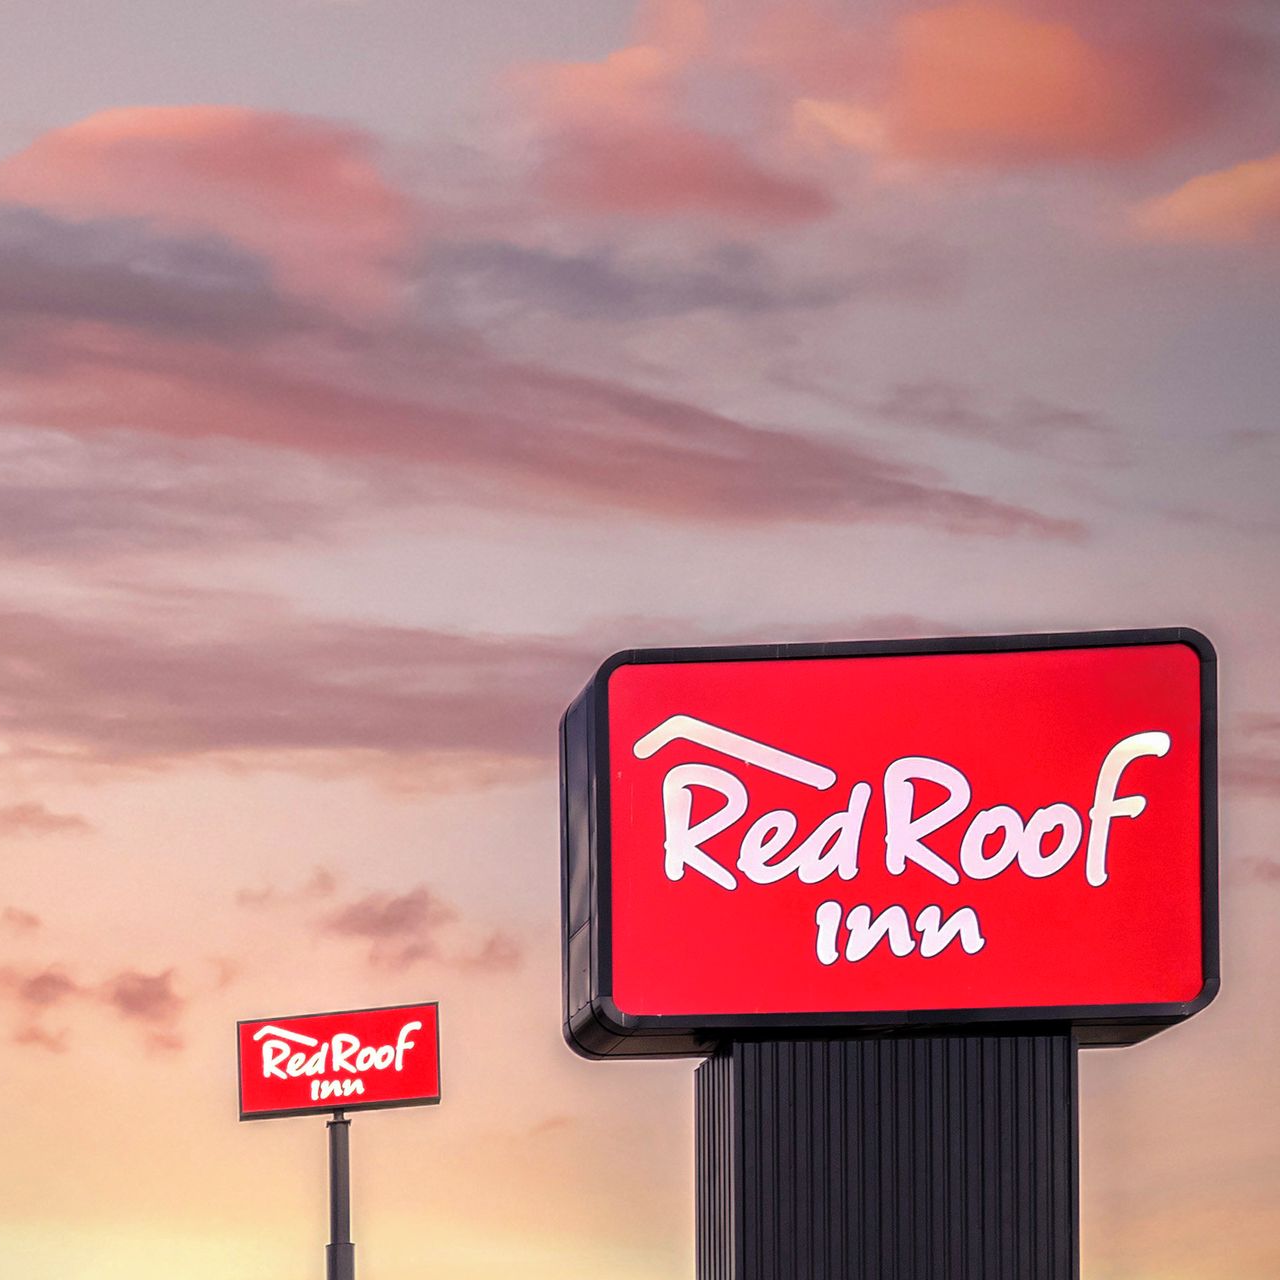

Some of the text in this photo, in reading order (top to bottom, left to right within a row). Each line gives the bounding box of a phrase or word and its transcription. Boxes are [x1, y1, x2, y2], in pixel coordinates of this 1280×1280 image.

[662, 731, 1171, 890] Red Roof
[262, 1021, 423, 1080] Red Roof
